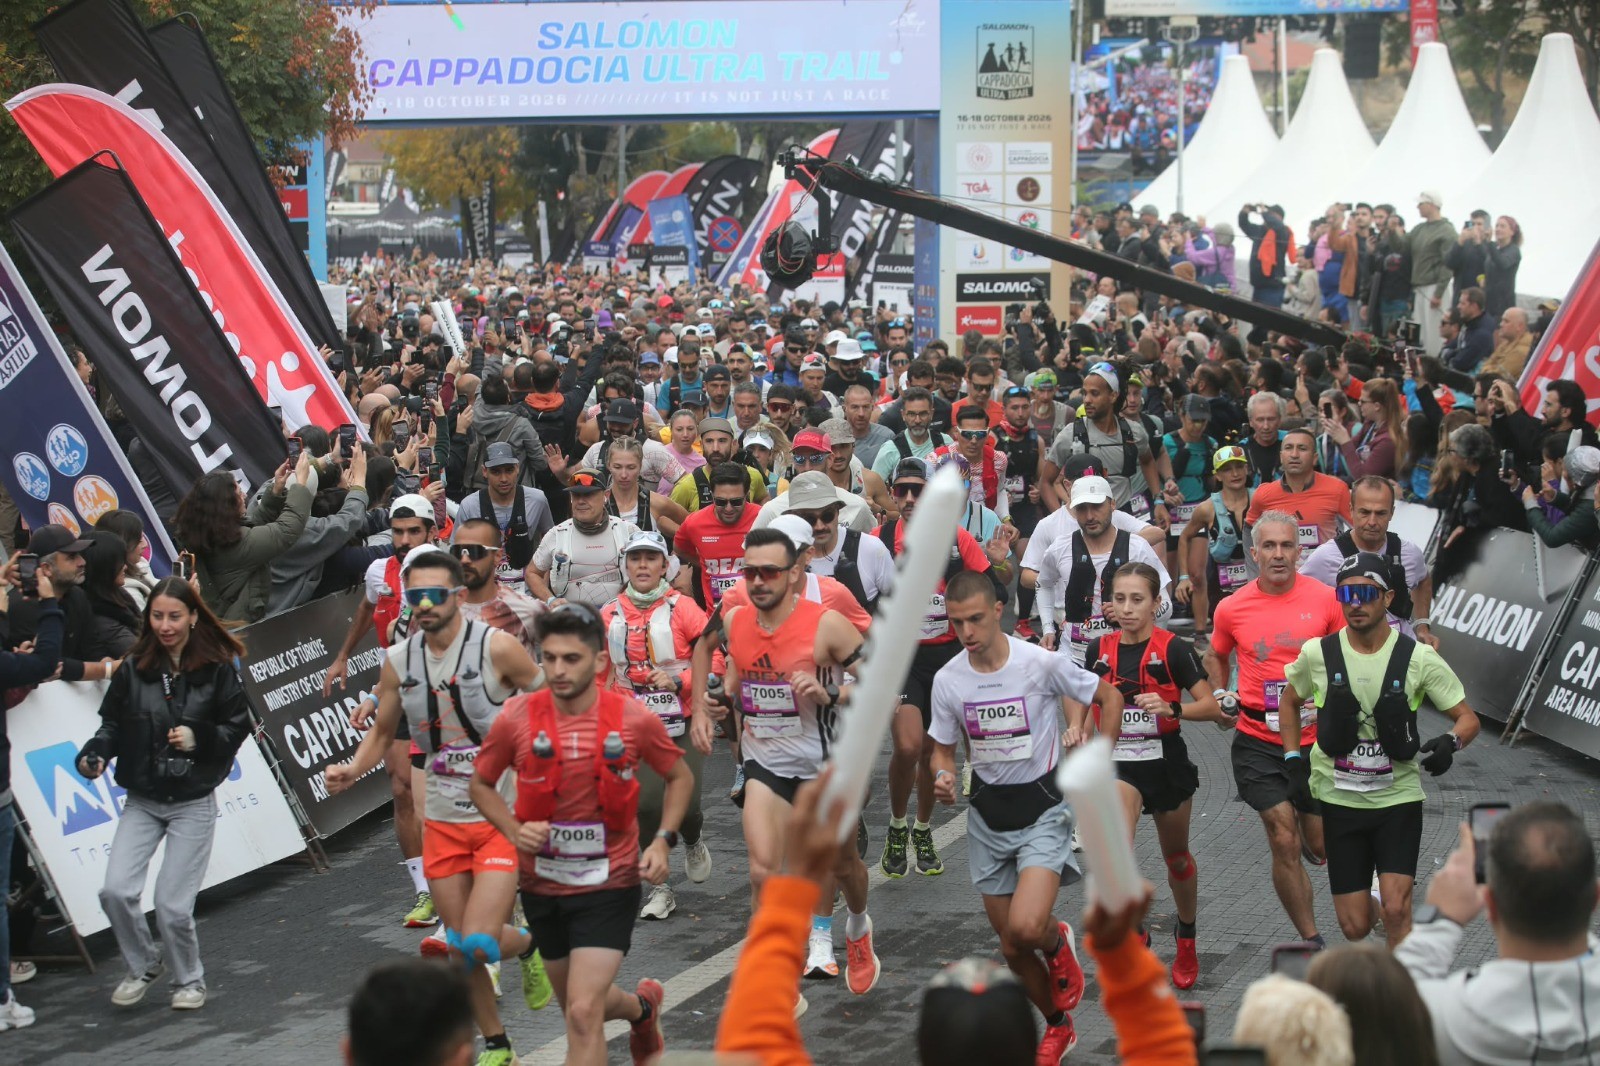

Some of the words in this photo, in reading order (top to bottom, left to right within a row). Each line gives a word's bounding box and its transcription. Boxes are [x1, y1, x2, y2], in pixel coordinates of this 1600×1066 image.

[538, 18, 738, 50] SALOMON
[368, 54, 631, 88] CAPPADOCIA
[642, 51, 766, 83] ULTRA
[778, 50, 890, 81] TRAIL
[979, 74, 1031, 88] CAPPADOCIA
[675, 91, 692, 103] IT
[701, 91, 720, 103] IS
[728, 91, 763, 103] NOT
[772, 90, 814, 102] JUST
[824, 89, 835, 100] A
[843, 89, 891, 101] RACE
[981, 87, 1005, 99] ULTRA
[1008, 87, 1029, 99] TRAIL
[423, 93, 511, 109] OCTOBER
[520, 93, 568, 107] 2026
[962, 180, 991, 195] TGA
[652, 254, 686, 262] GARMIN
[876, 264, 914, 274] SALOMO
[963, 281, 1035, 294] SALOMO
[249, 652, 290, 684] REPUBLIC
[297, 637, 329, 665] TÜRKİYE
[262, 680, 305, 712] MINISTRY
[645, 694, 673, 704] 7689
[752, 687, 786, 699] 7005
[977, 705, 1016, 720] 7002
[1544, 684, 1577, 716] AREA
[1571, 694, 1600, 728] MAN
[1123, 711, 1150, 723] 006
[447, 751, 479, 763] 700
[1356, 745, 1384, 758] 004
[551, 827, 595, 842] 7008
